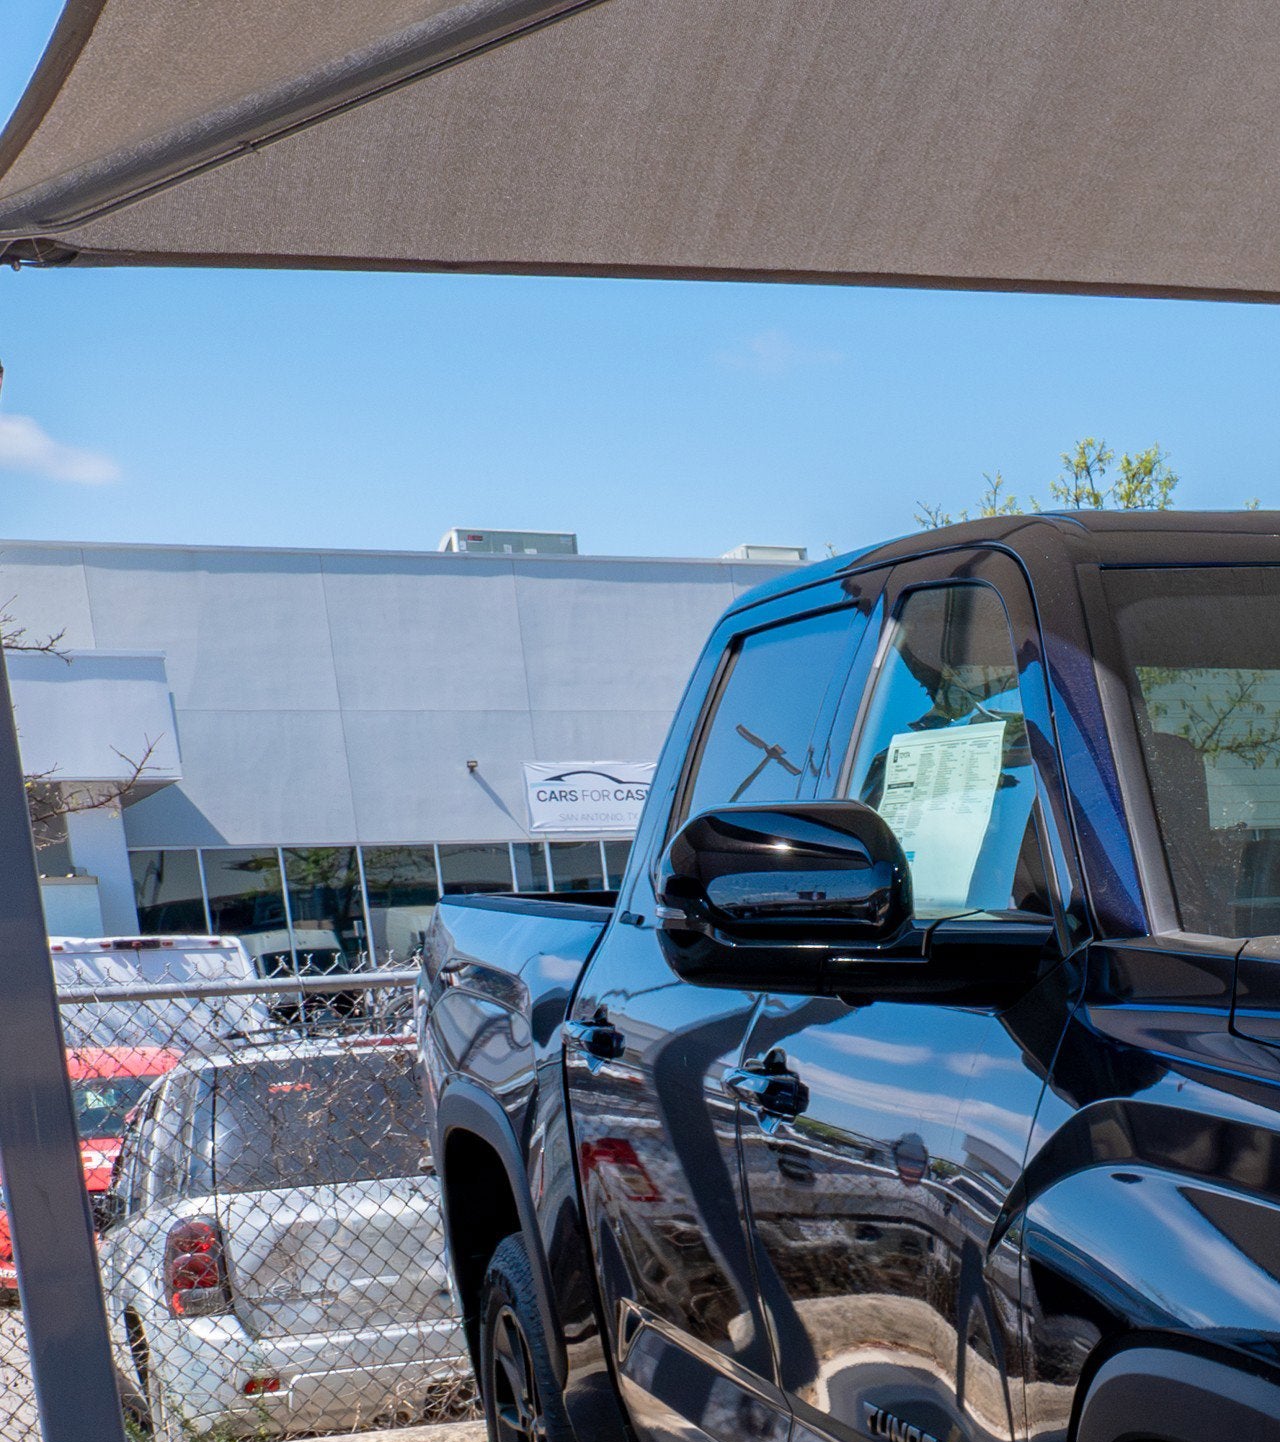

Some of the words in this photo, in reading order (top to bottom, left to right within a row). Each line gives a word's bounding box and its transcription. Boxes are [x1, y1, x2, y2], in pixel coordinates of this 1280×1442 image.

[537, 790, 579, 802] CARS
[582, 790, 612, 802] FOR
[559, 813, 579, 821] SAN
